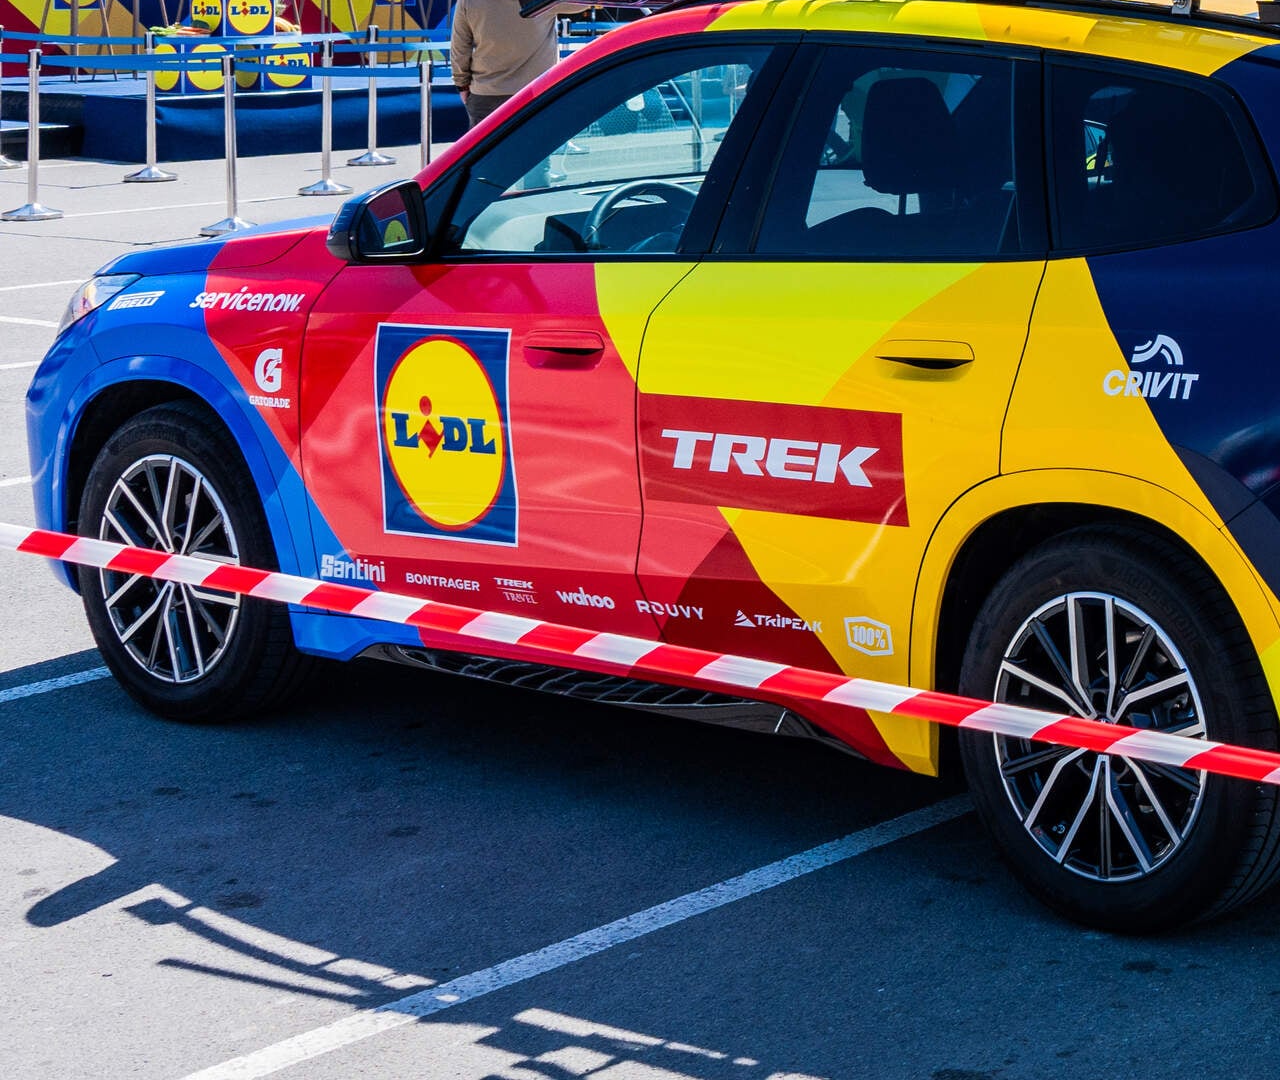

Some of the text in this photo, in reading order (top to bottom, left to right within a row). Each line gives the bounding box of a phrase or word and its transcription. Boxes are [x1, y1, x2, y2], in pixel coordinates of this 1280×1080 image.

[107, 291, 165, 311] PIRELLI
[1102, 369, 1200, 400] CRIVIT
[249, 395, 291, 409] GATORADE
[661, 429, 880, 488] TREK
[320, 554, 386, 582] Santini
[405, 572, 480, 592] BONTRAGER
[494, 577, 533, 589] TREK
[503, 592, 539, 605] TRAVEL
[555, 587, 615, 609] wahoo
[635, 600, 704, 620] ROUVY
[852, 625, 886, 648] 100%
